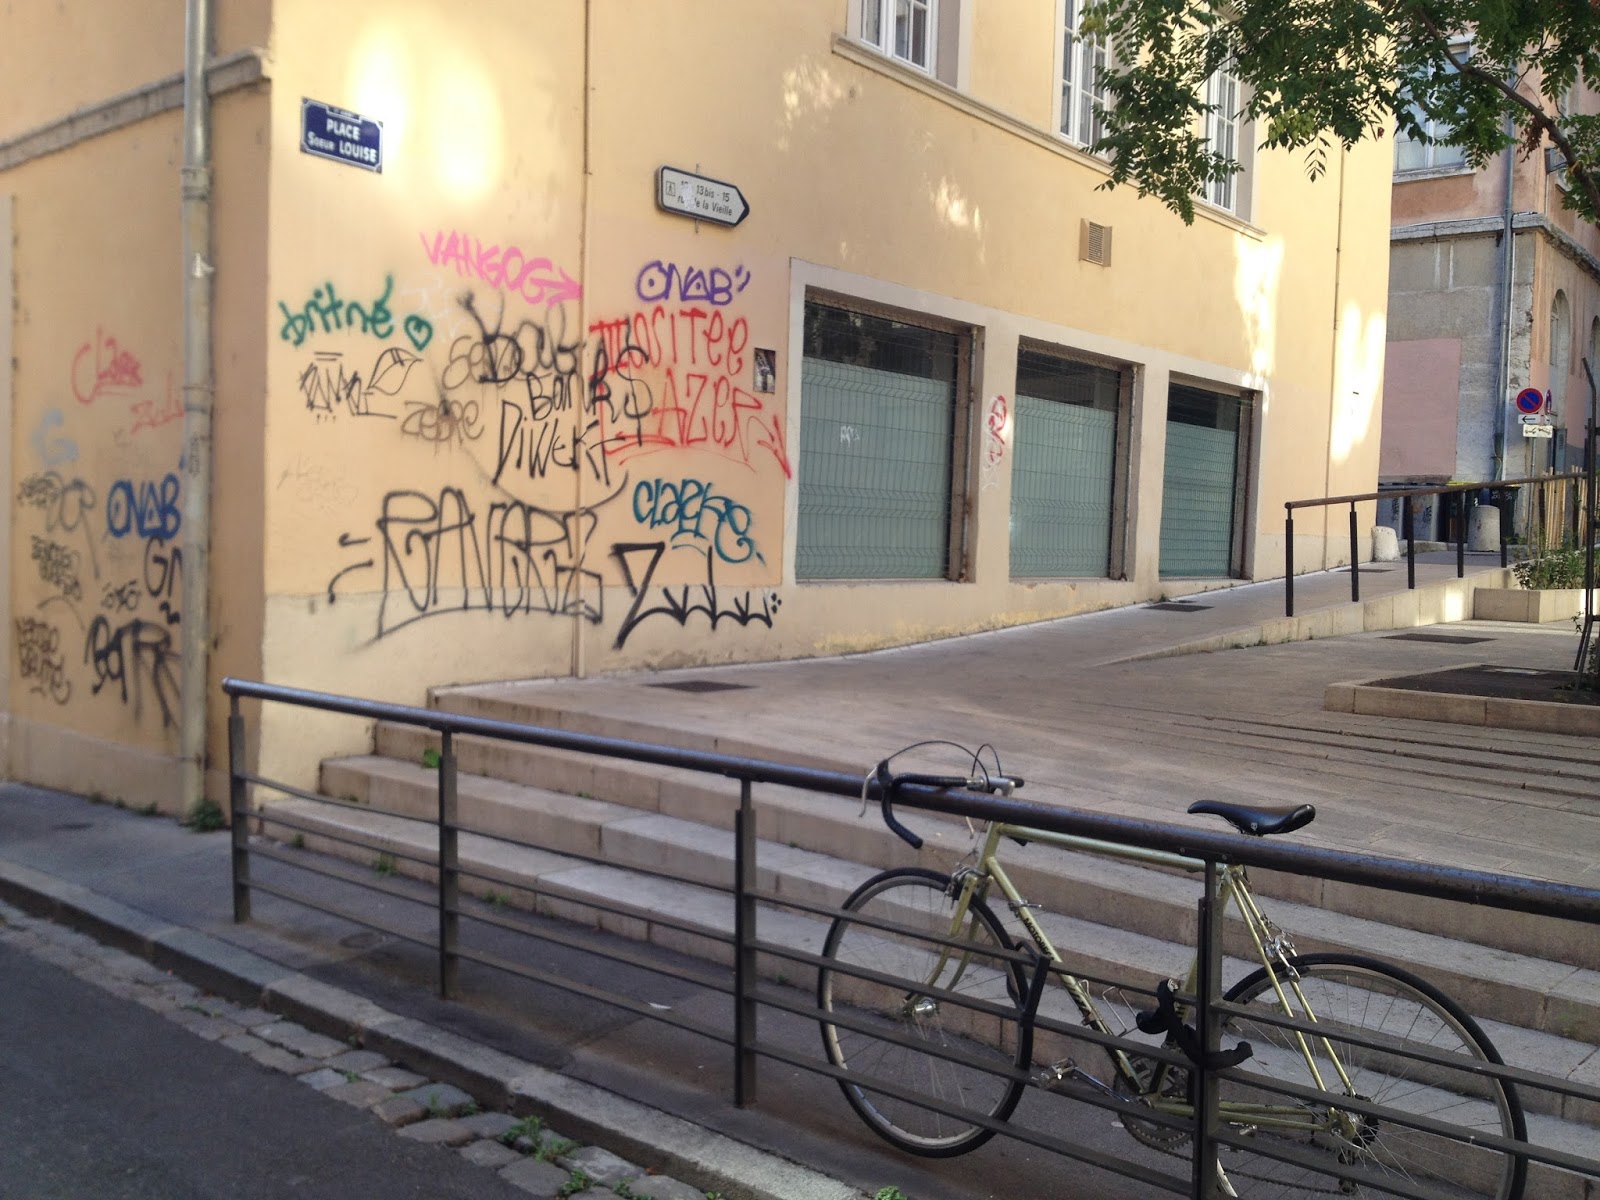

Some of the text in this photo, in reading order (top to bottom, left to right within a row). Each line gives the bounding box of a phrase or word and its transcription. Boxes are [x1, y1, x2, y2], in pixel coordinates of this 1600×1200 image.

[326, 118, 361, 141] PLACE
[339, 140, 377, 163] LOUISE
[722, 191, 730, 202] 15
[702, 199, 709, 210] la
[712, 201, 733, 216] Vieille
